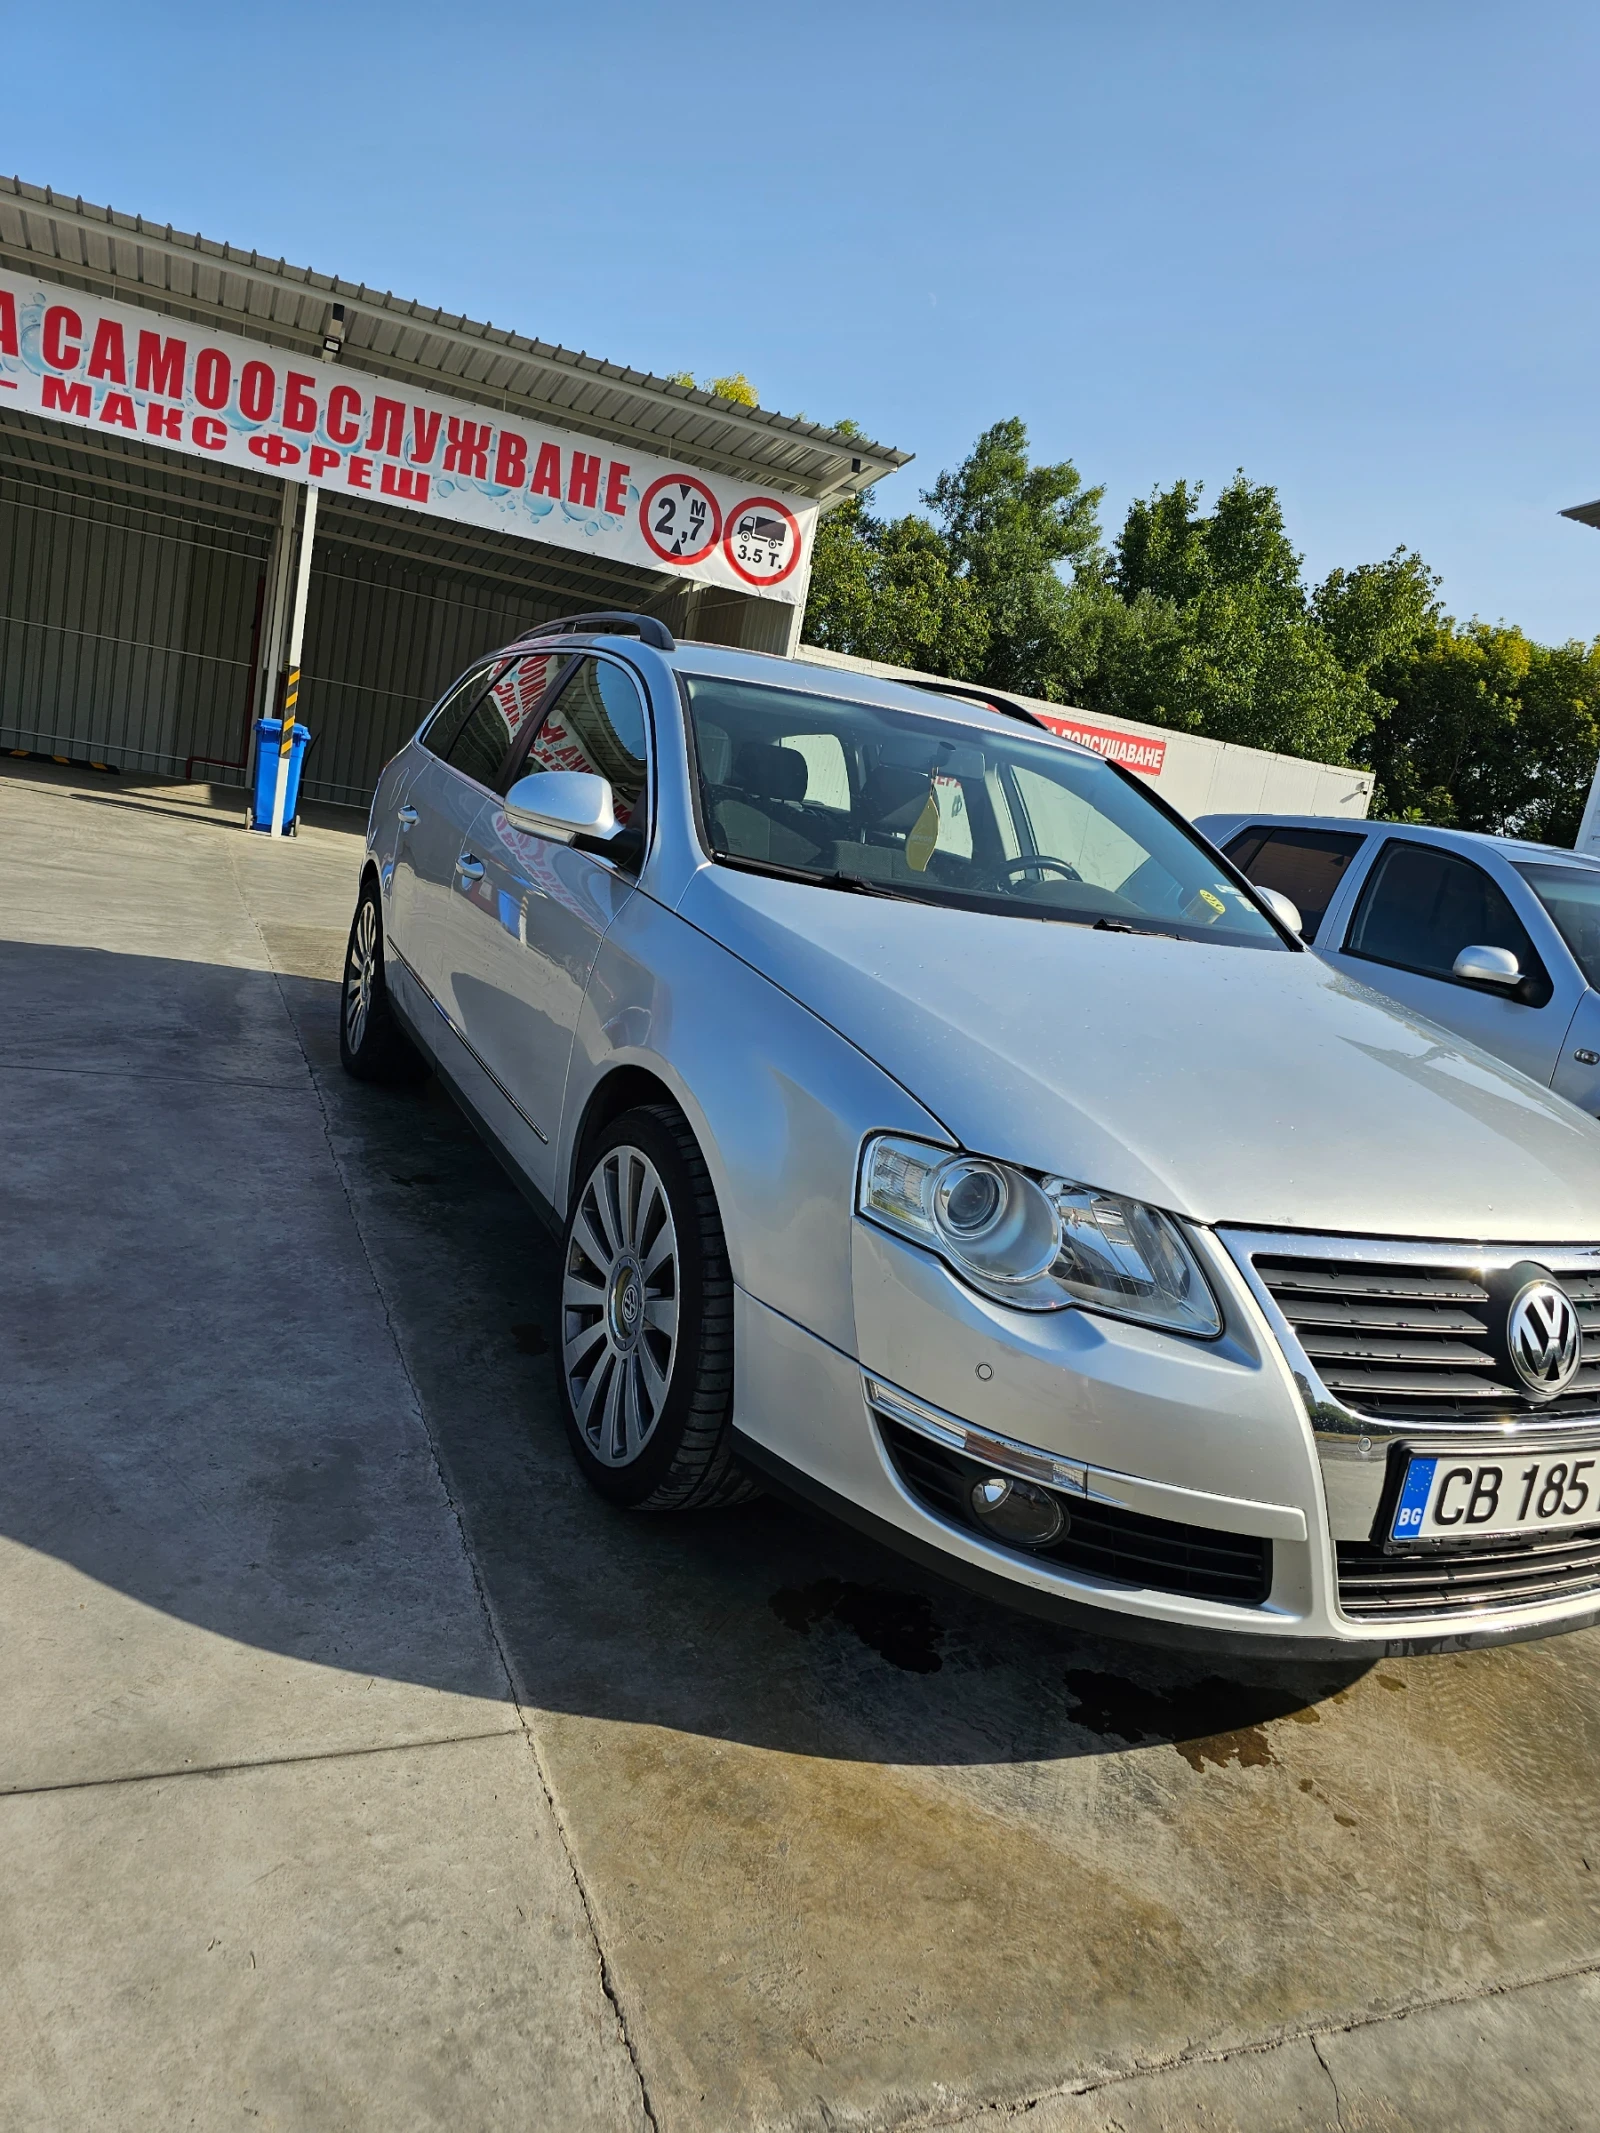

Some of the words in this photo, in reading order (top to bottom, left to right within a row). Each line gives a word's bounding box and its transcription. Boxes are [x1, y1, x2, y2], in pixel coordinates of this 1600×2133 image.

[41, 375, 228, 451] МАКС
[248, 433, 430, 503] ФРЕШ
[42, 304, 630, 516] САМООБСЛУЖВАНЕ
[737, 544, 764, 564] 3.5
[1398, 1507, 1423, 1525] BG
[1434, 1467, 1503, 1526] CB
[1518, 1459, 1596, 1520] 185
